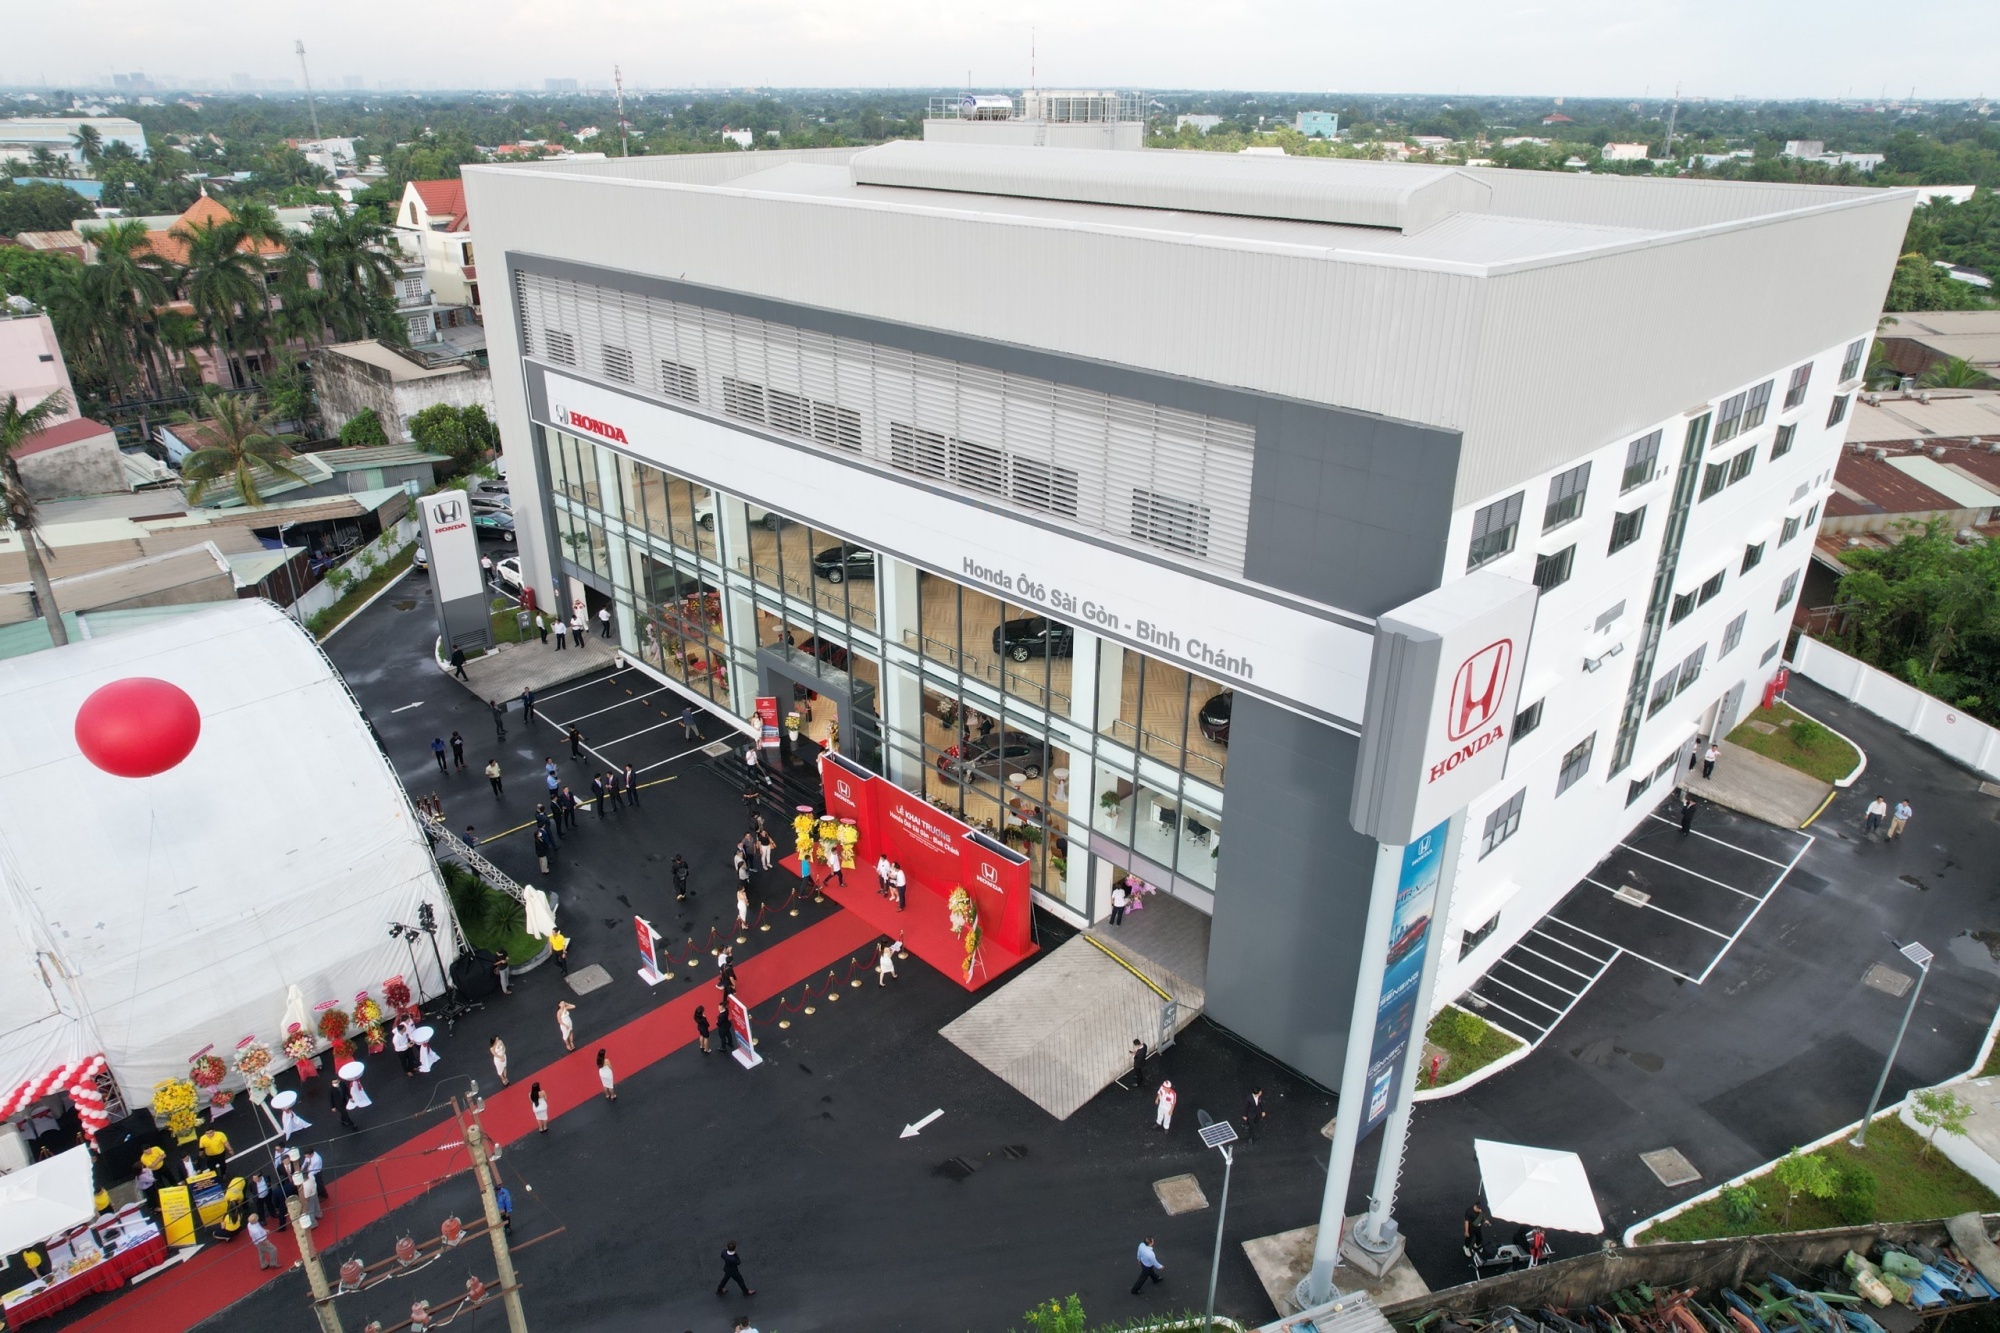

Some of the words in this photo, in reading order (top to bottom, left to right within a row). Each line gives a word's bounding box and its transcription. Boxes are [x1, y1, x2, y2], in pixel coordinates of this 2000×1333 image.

[569, 411, 629, 444] HONDA
[434, 523, 467, 534] HONDA
[963, 556, 1012, 590] Honda
[1017, 573, 1046, 602] Ôtô
[1050, 589, 1077, 614] Sài
[1082, 601, 1119, 629] Gòn
[1136, 619, 1180, 652] Bình
[1187, 638, 1253, 679] Chánh
[1428, 724, 1504, 785] HONDA
[834, 791, 856, 808] HONDA
[905, 811, 921, 825] KHAI
[1411, 849, 1433, 867] HONDA
[976, 875, 1004, 894] HONDA
[1163, 1014, 1176, 1026] OUT
